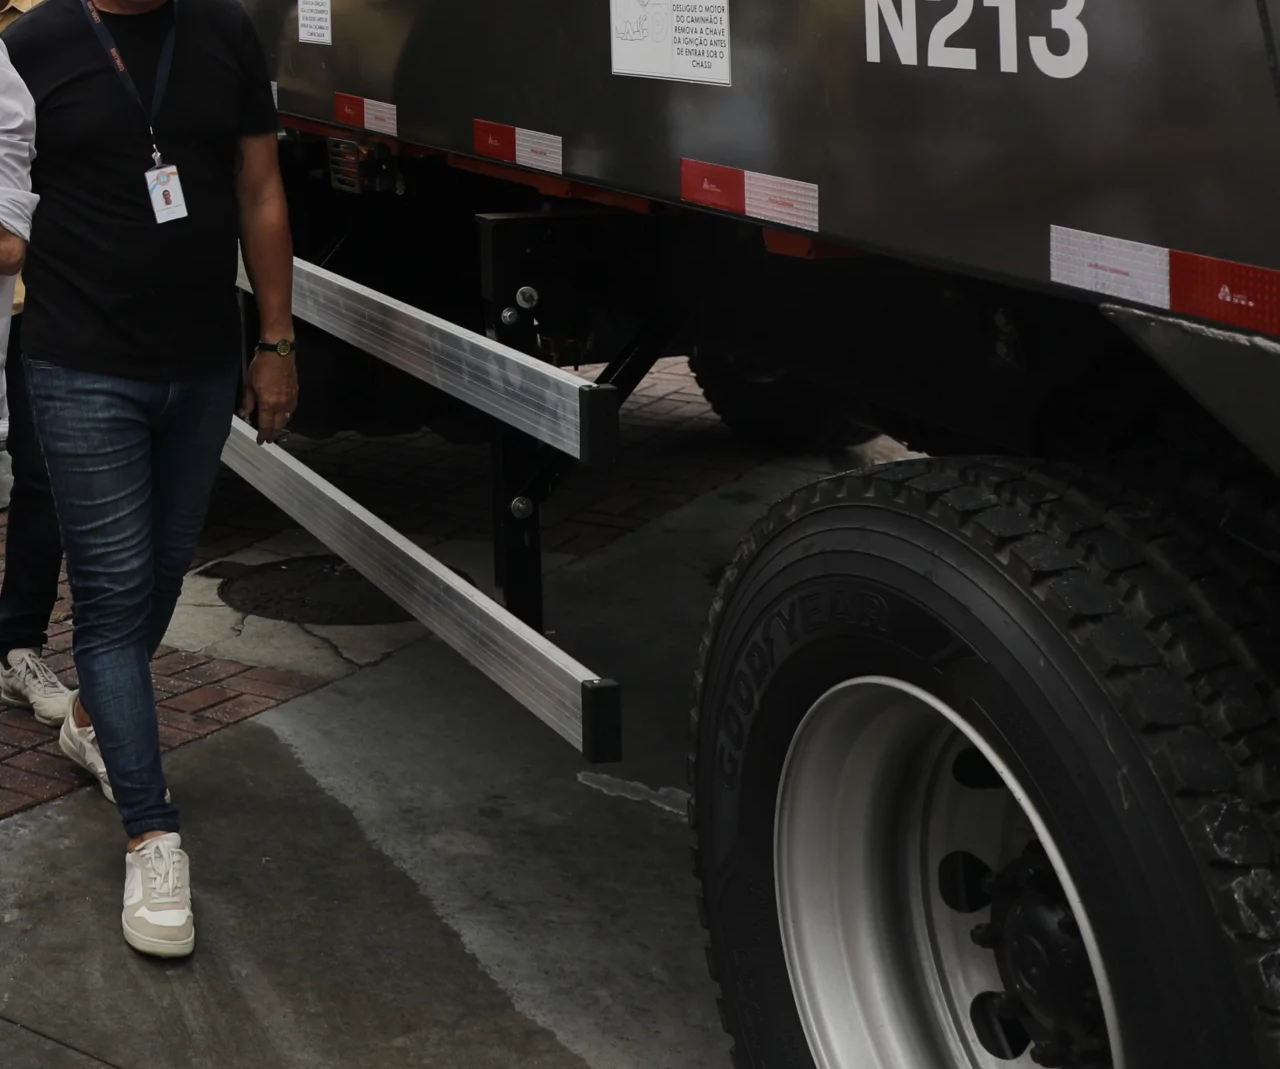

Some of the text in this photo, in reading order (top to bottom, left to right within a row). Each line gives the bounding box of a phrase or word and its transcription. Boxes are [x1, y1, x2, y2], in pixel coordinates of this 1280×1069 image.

[672, 4, 697, 12] DESLIGUE
[704, 5, 725, 14] MOTOR
[676, 15, 685, 23] DO
[686, 14, 718, 24] CAMINHÃO
[674, 26, 698, 34] REMOVA
[705, 28, 725, 36] CHAVE
[683, 37, 708, 47] IGNIÇÃO
[710, 39, 726, 48] ANTES
[685, 48, 705, 57] ENTRAR
[706, 50, 718, 58] SOB
[692, 60, 712, 69] CHASSI
[721, 588, 888, 789] GOODYEAR
